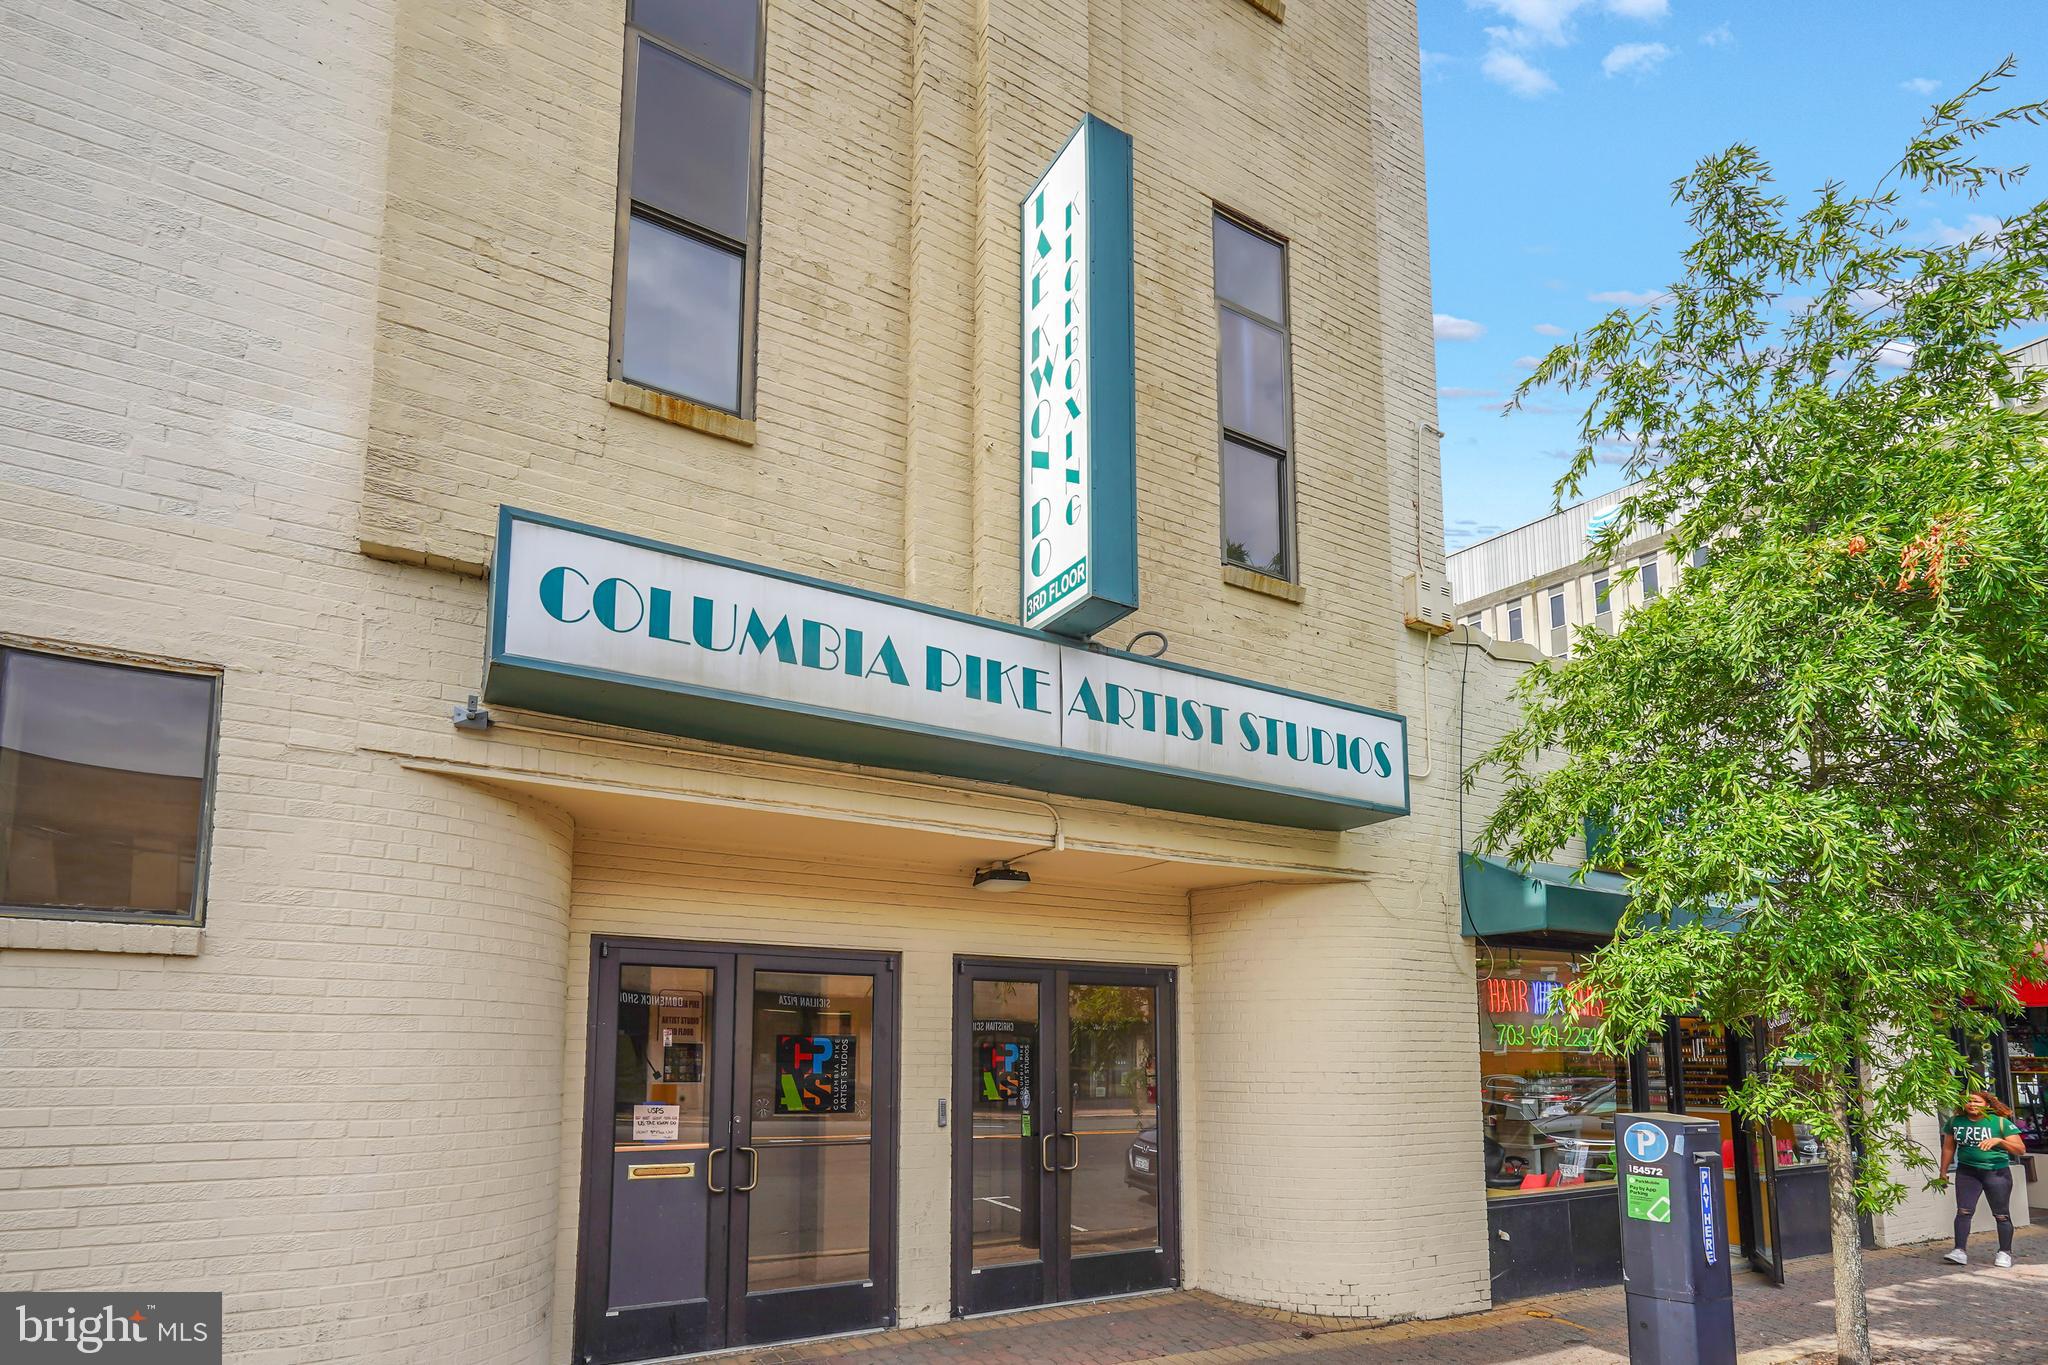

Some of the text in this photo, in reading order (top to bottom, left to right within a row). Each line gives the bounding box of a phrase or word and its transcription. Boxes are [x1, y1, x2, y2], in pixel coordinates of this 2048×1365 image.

[1030, 182, 1058, 578] TAEKWON DO
[1065, 191, 1082, 526] KICKBOXING
[1027, 562, 1086, 616] 3RD FLOOR
[538, 565, 1392, 779] COLUMBIA PIKE ARTIST STUDIOS
[1487, 978, 1529, 1013] HAIR
[833, 1038, 841, 1059] PIKE
[840, 1038, 849, 1110] ARTIST STUDIOS
[647, 1107, 665, 1115] USPS
[1637, 1129, 1656, 1156] P
[1628, 1164, 1663, 1176] 154572
[1701, 1170, 1714, 1262] PAY HERE
